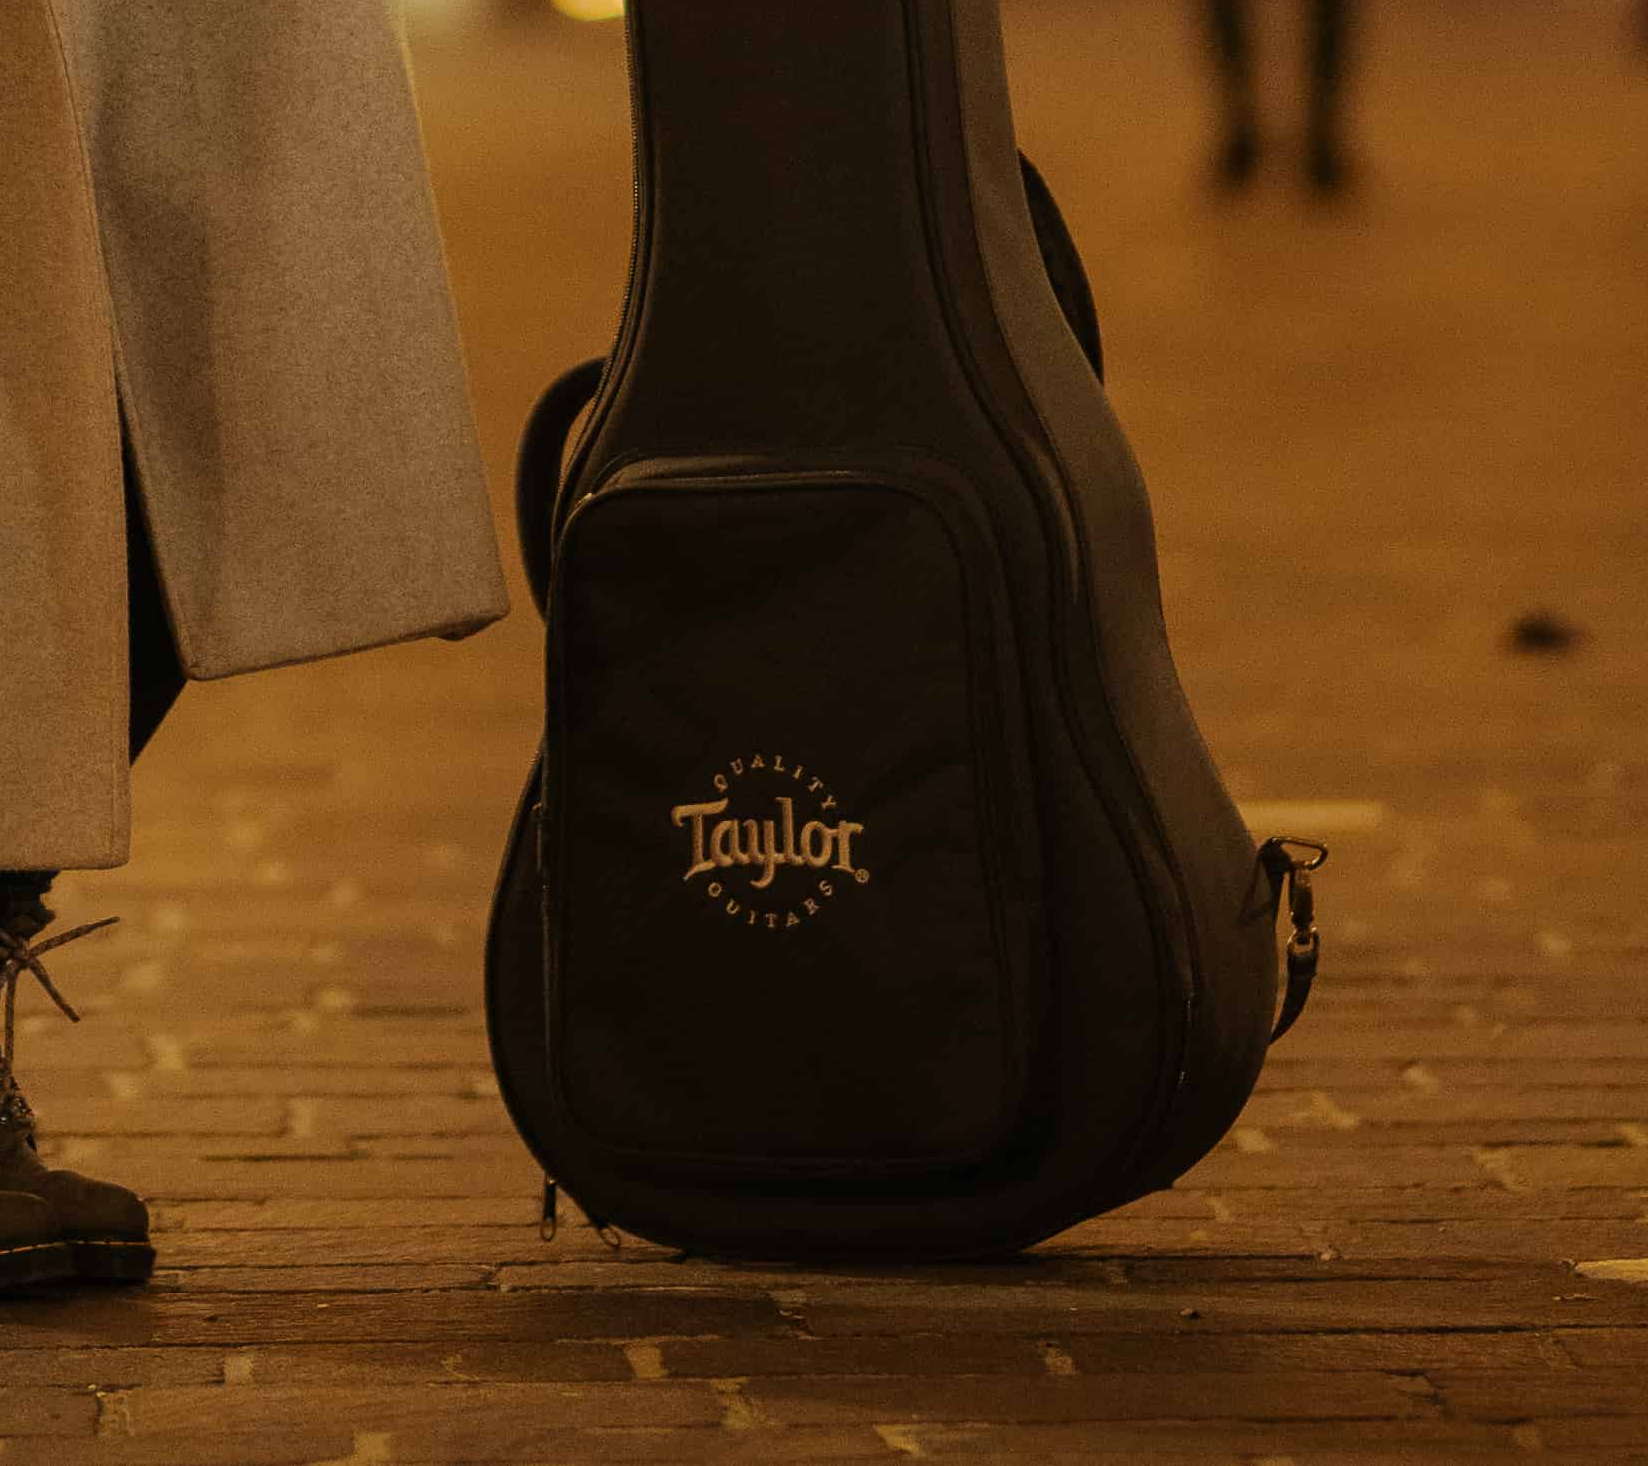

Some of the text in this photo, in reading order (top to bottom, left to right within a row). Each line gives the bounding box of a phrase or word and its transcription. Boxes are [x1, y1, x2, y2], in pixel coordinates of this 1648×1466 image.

[713, 752, 837, 810] QUALITY
[670, 796, 865, 889] Taylor
[707, 879, 833, 929] GUITARS
